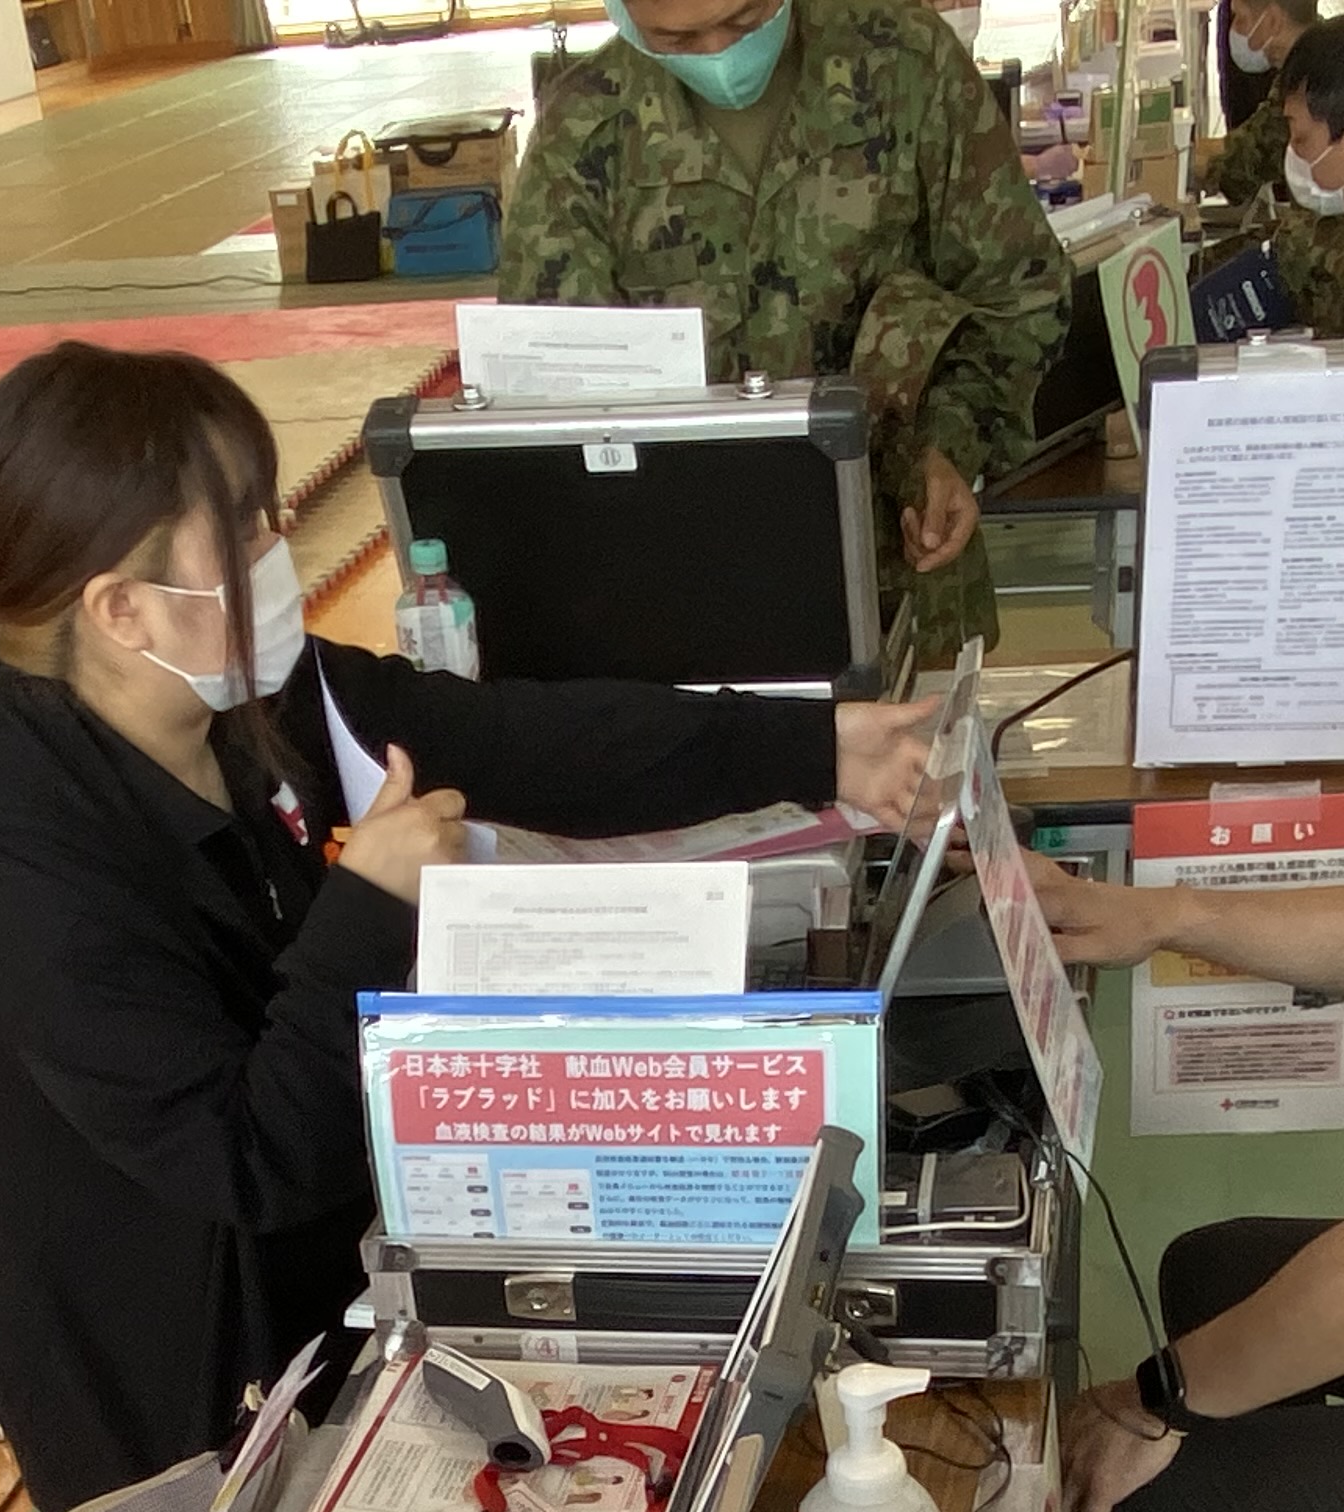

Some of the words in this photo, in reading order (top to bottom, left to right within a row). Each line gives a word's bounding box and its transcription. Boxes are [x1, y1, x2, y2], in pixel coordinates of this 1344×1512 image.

[404, 1053, 543, 1079] 日本赤十字社
[565, 1053, 808, 1079] 献血Web会員サービス
[434, 1122, 783, 1145] 血液検査の結果がWebサイトで見れます
